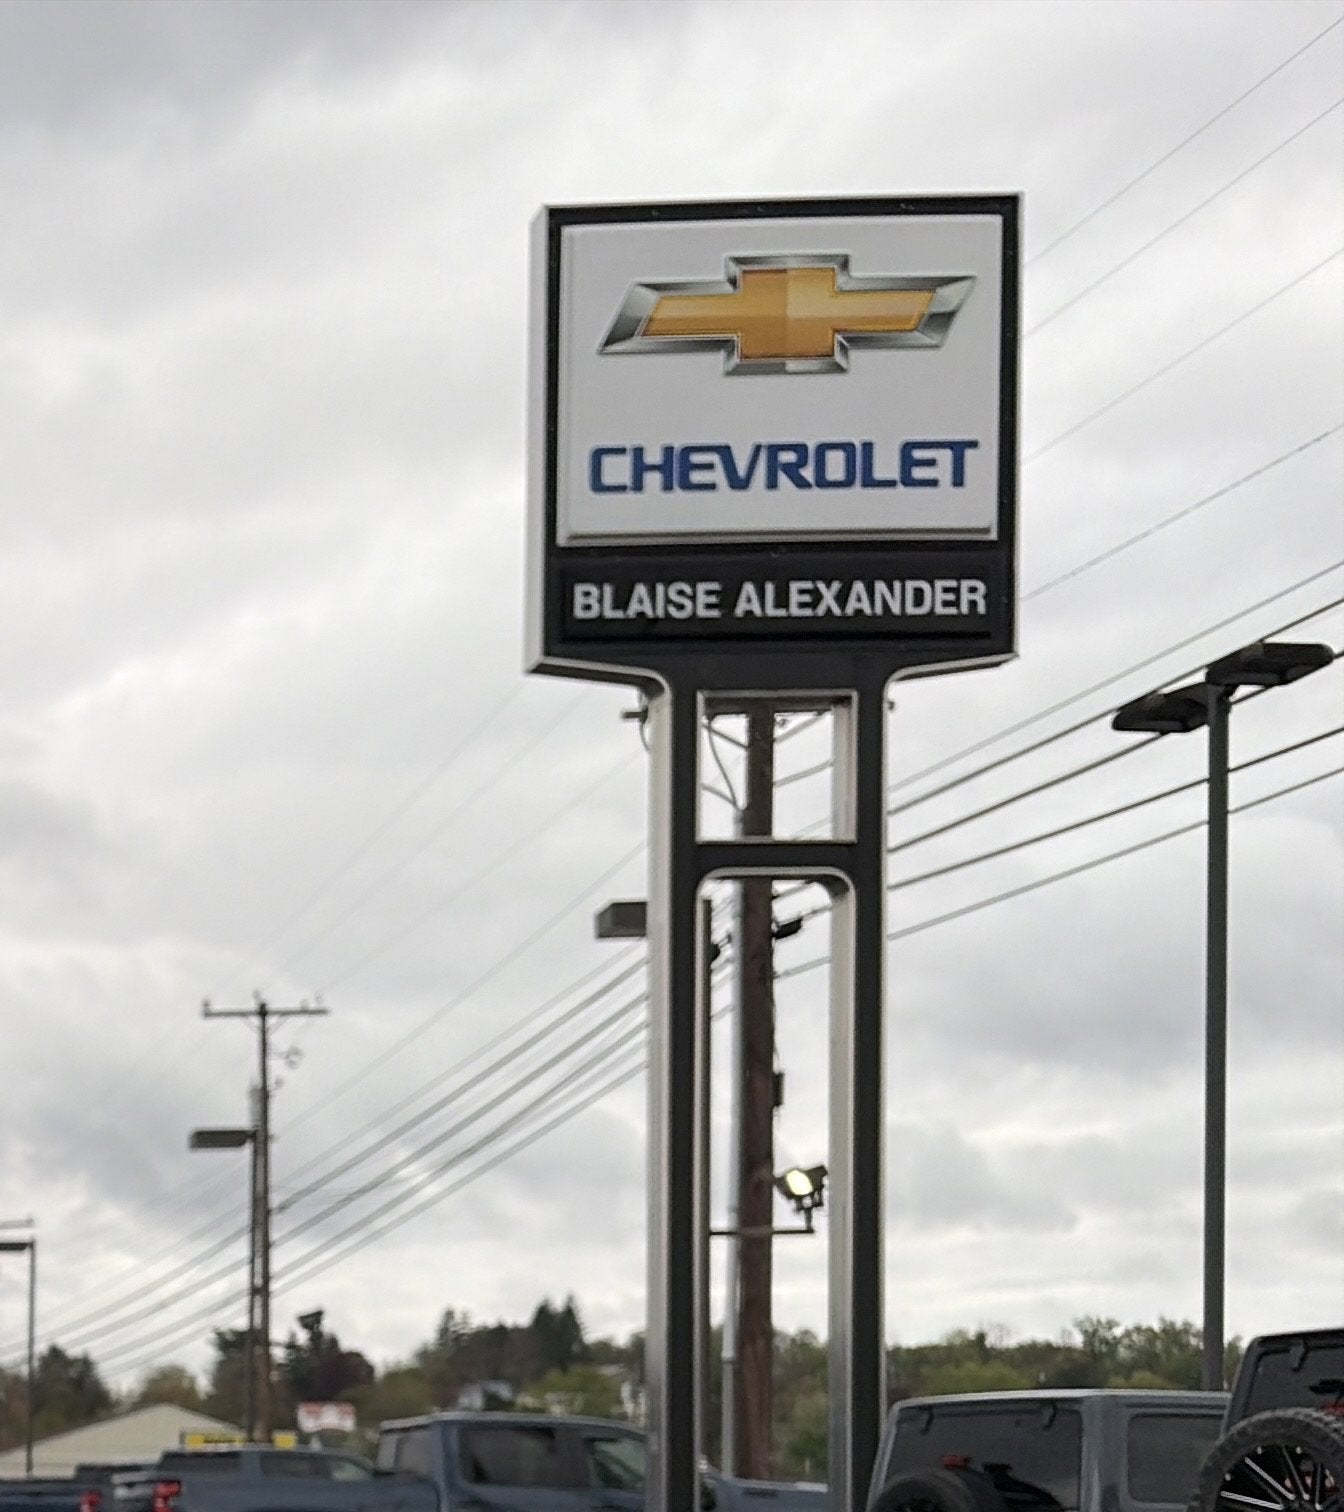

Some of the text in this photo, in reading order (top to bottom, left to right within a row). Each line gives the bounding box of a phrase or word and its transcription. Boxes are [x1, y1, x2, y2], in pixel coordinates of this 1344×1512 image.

[589, 439, 979, 494] CHEVROLET
[573, 578, 987, 620] BLAISE ALEXANDER
